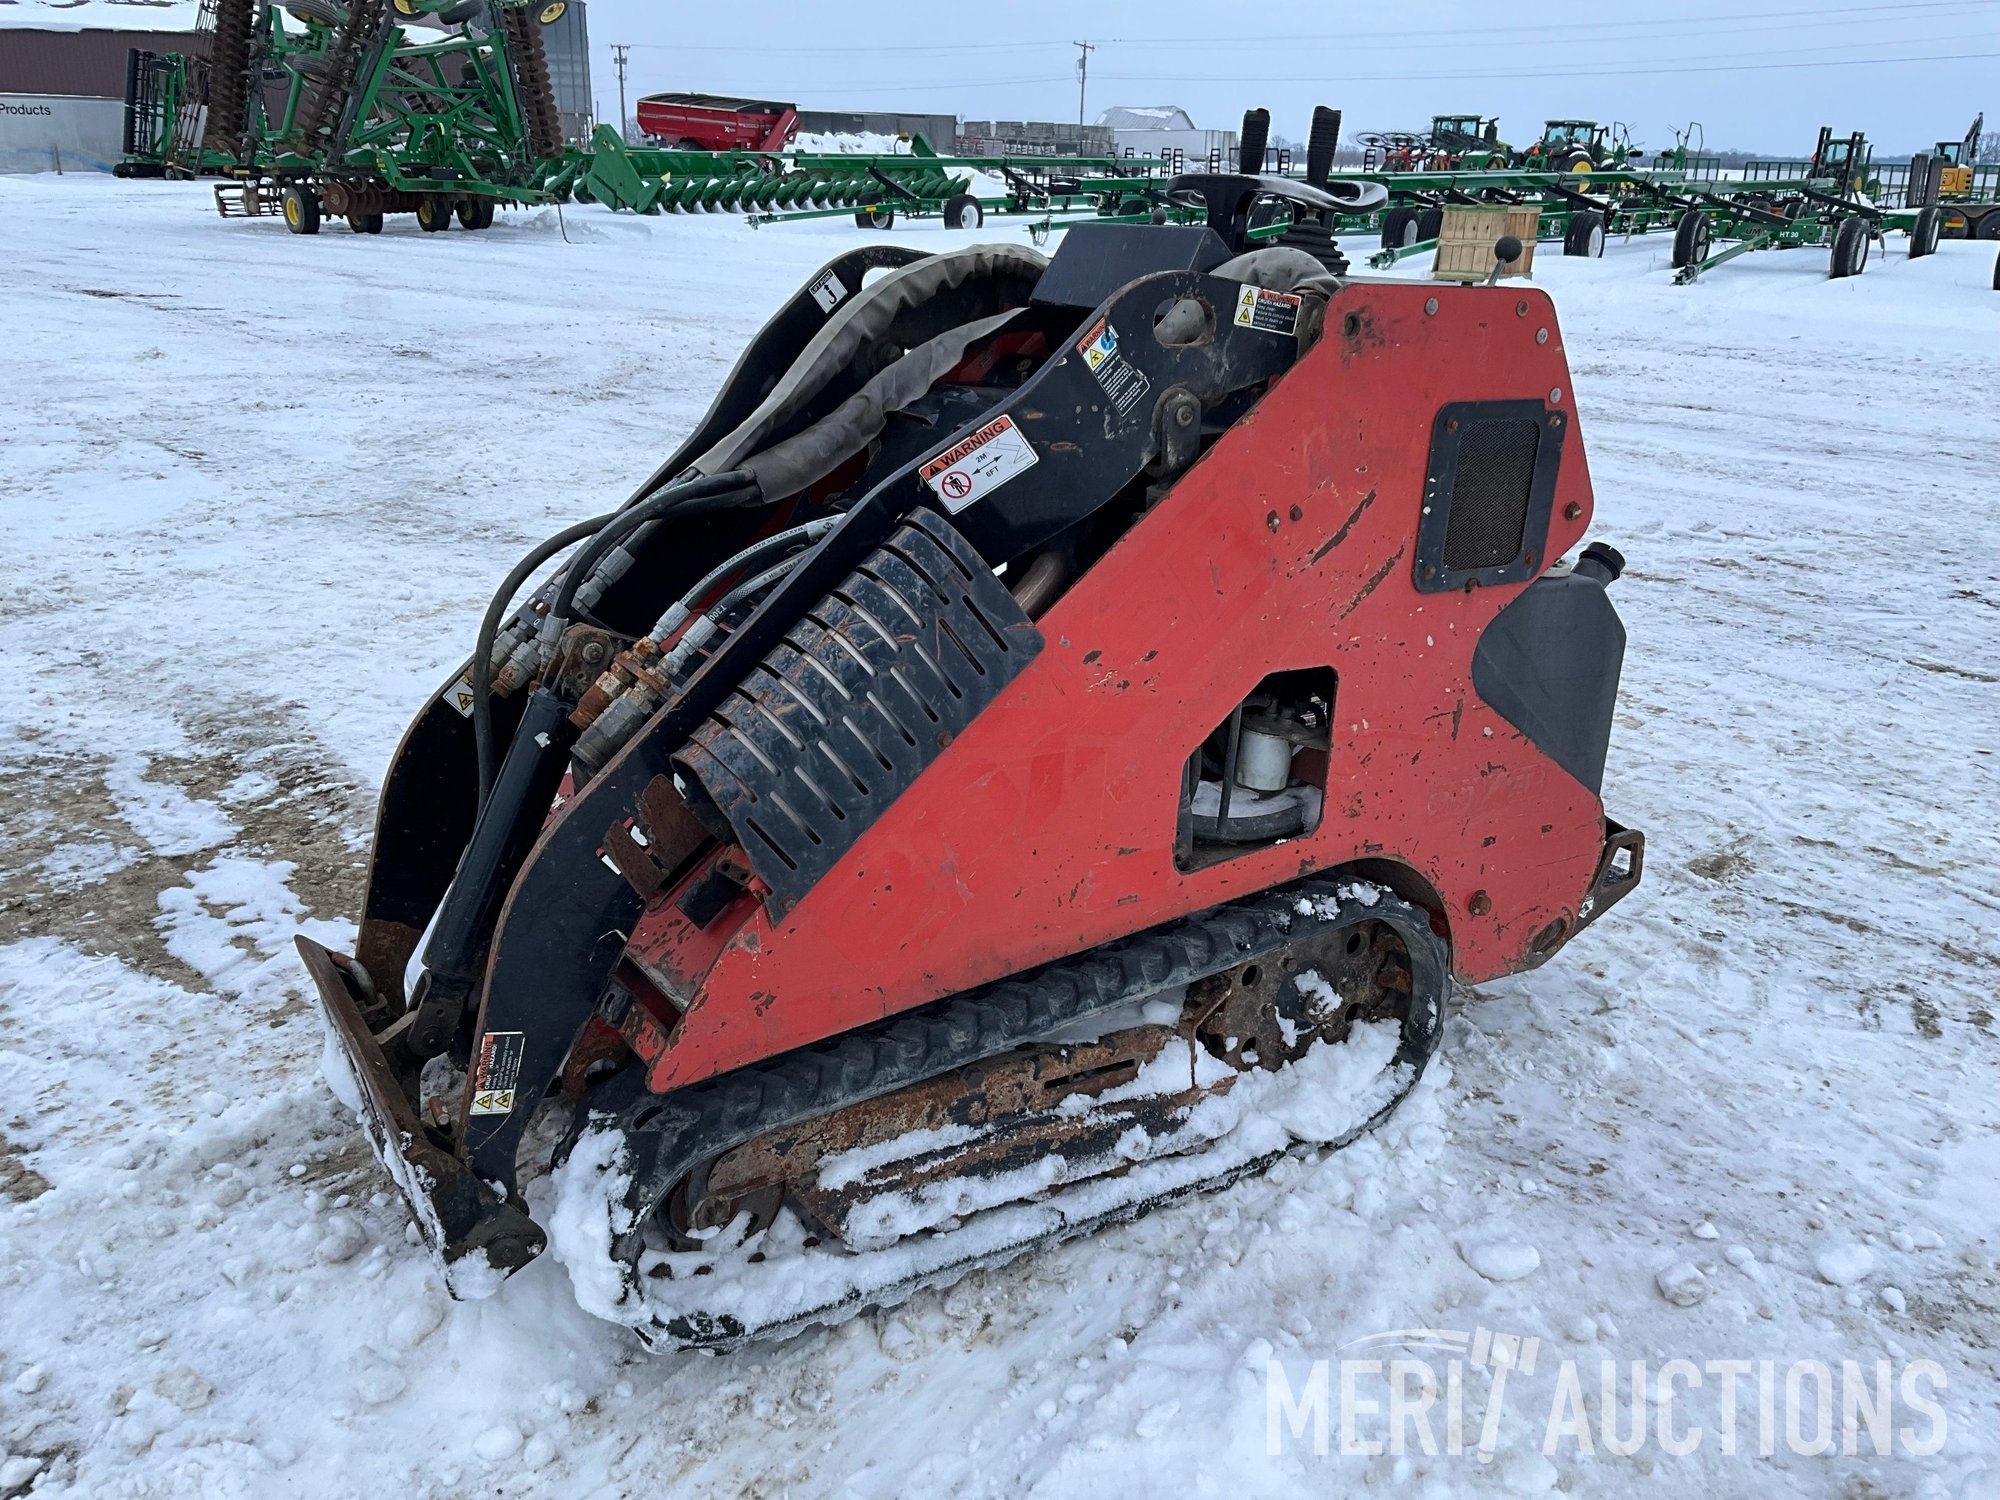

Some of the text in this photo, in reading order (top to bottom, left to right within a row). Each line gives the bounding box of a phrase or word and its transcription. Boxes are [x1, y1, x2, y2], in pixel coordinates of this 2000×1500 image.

[0, 103, 51, 115] Products
[941, 422, 1004, 466] WARNING
[976, 453, 987, 463] 2M
[708, 603, 727, 622] T300
